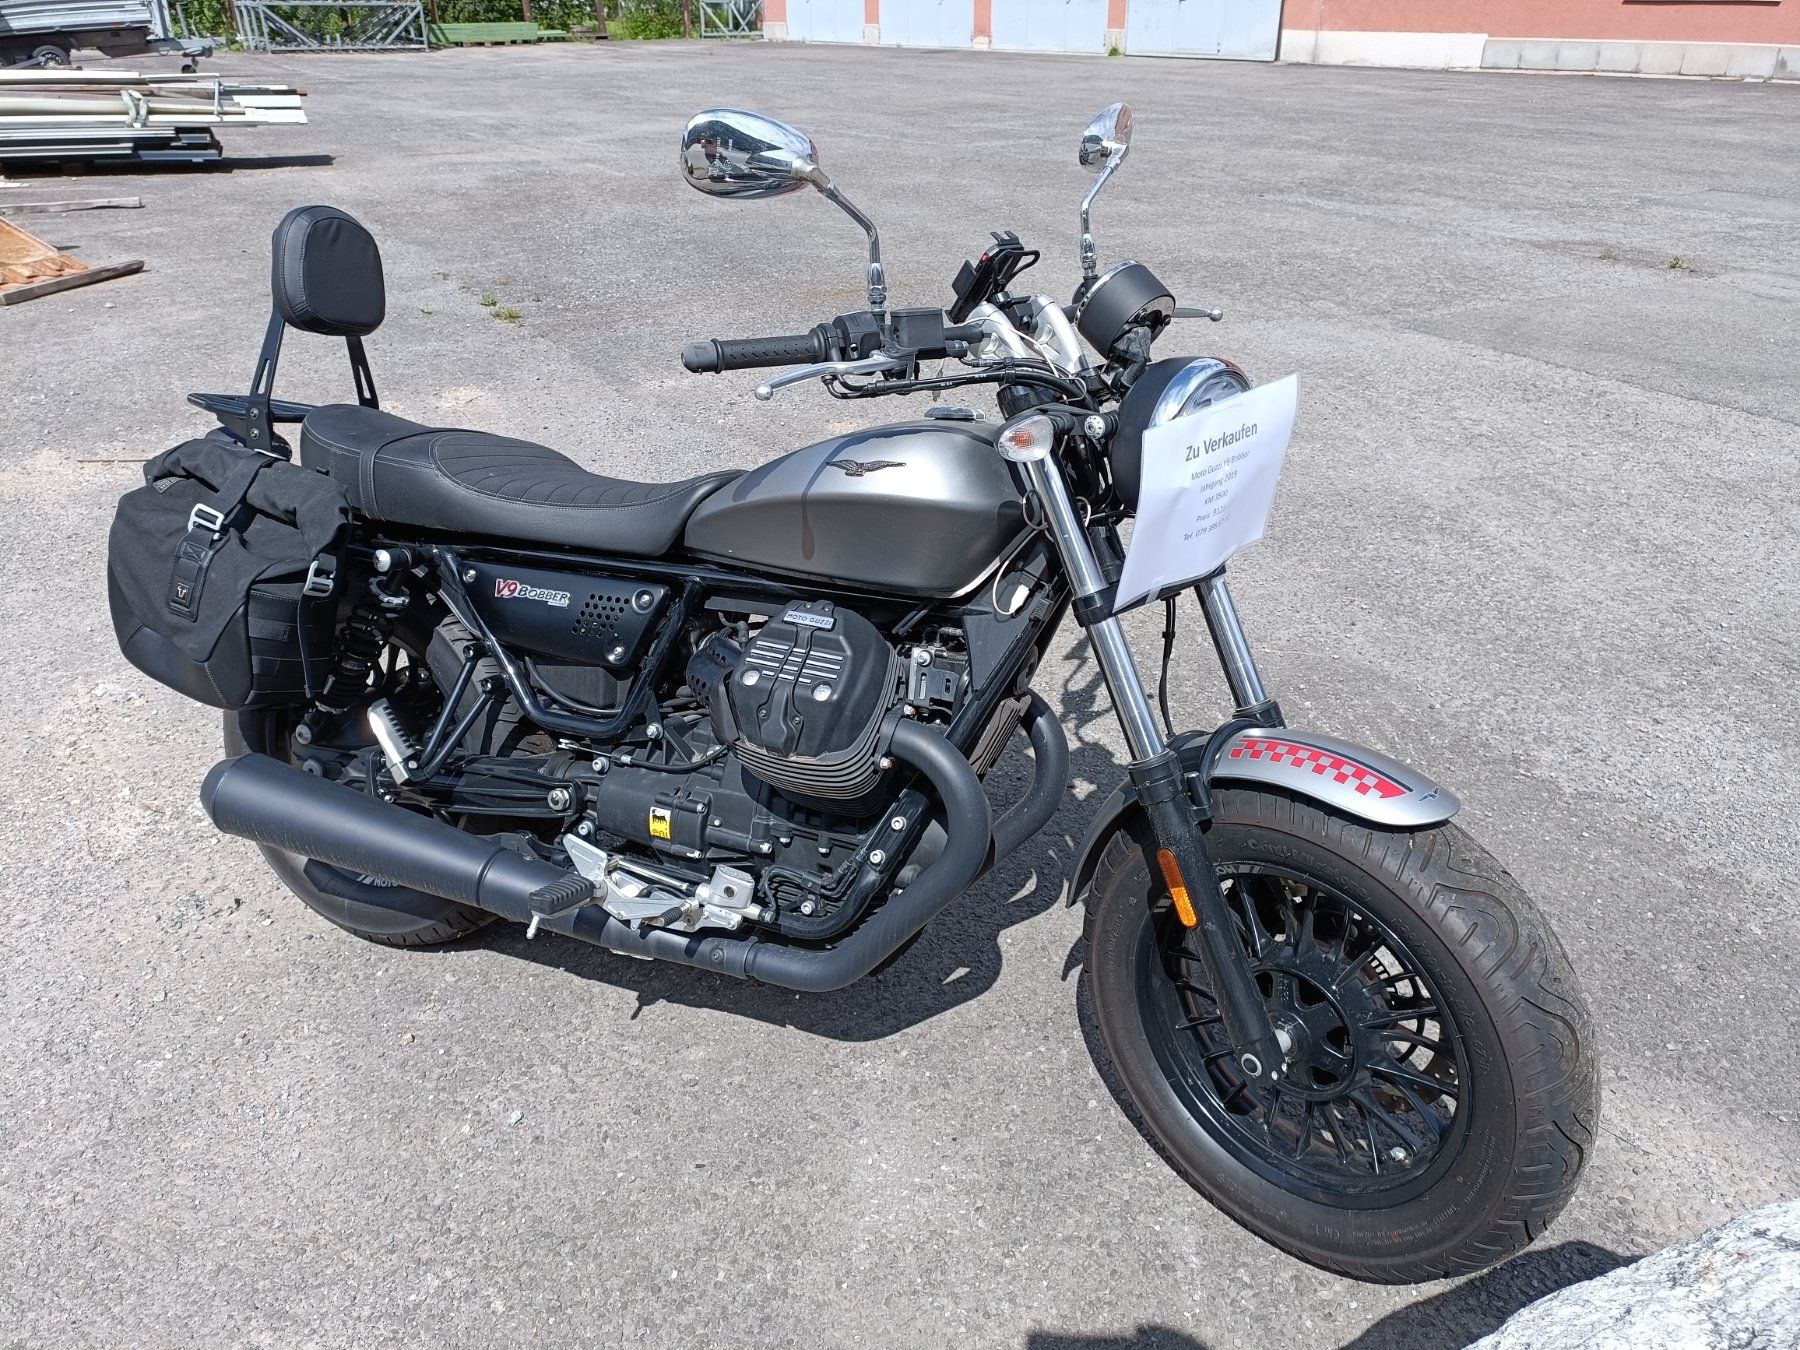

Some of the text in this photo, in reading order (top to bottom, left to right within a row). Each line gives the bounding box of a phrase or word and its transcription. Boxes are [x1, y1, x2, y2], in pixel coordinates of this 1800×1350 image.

[1185, 423, 1258, 461] Zu Verkaufen
[495, 579, 570, 603] V9 BOBBER
[786, 613, 831, 626] MOTO GUZZI
[651, 828, 669, 838] eni
